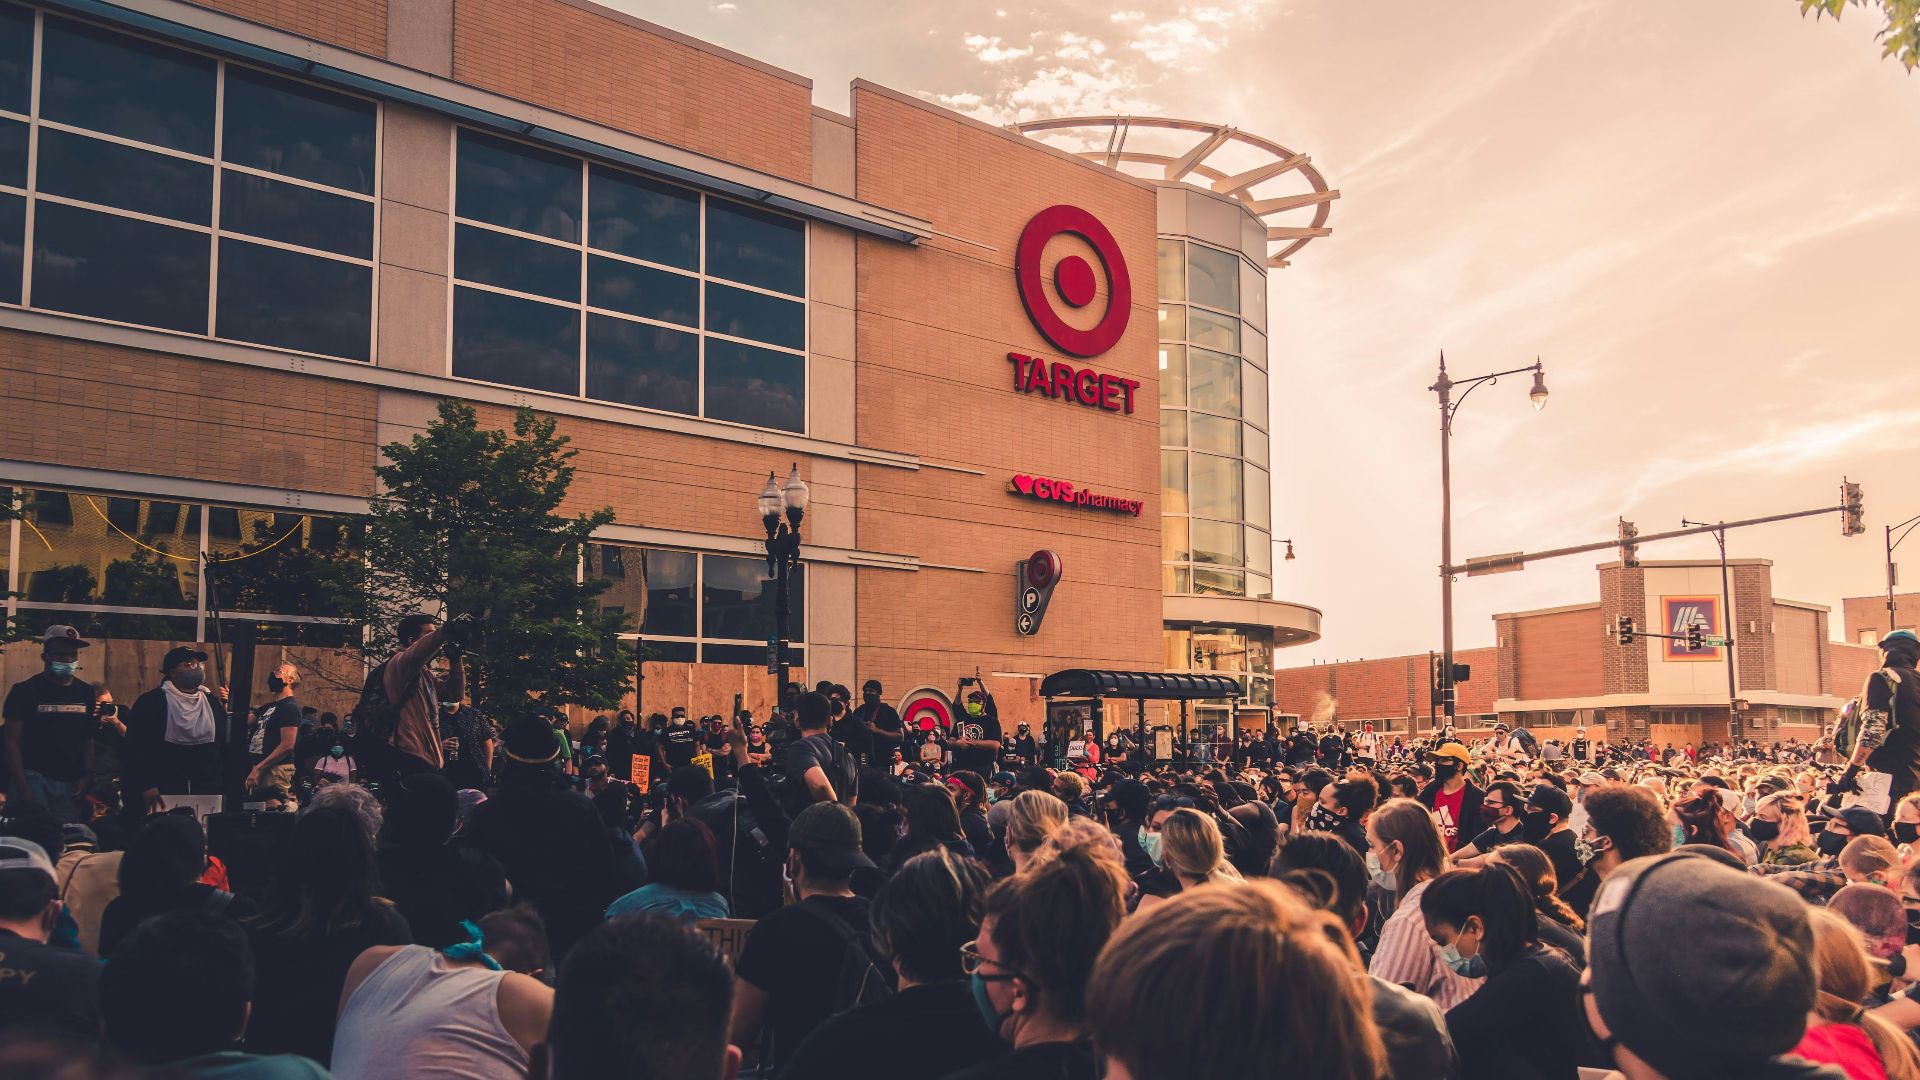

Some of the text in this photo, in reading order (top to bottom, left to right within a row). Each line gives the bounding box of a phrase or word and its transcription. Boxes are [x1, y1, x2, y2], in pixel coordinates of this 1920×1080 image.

[1007, 352, 1140, 414] TARGET
[1034, 478, 1144, 518] CVS pharmacy
[1026, 592, 1037, 609] P
